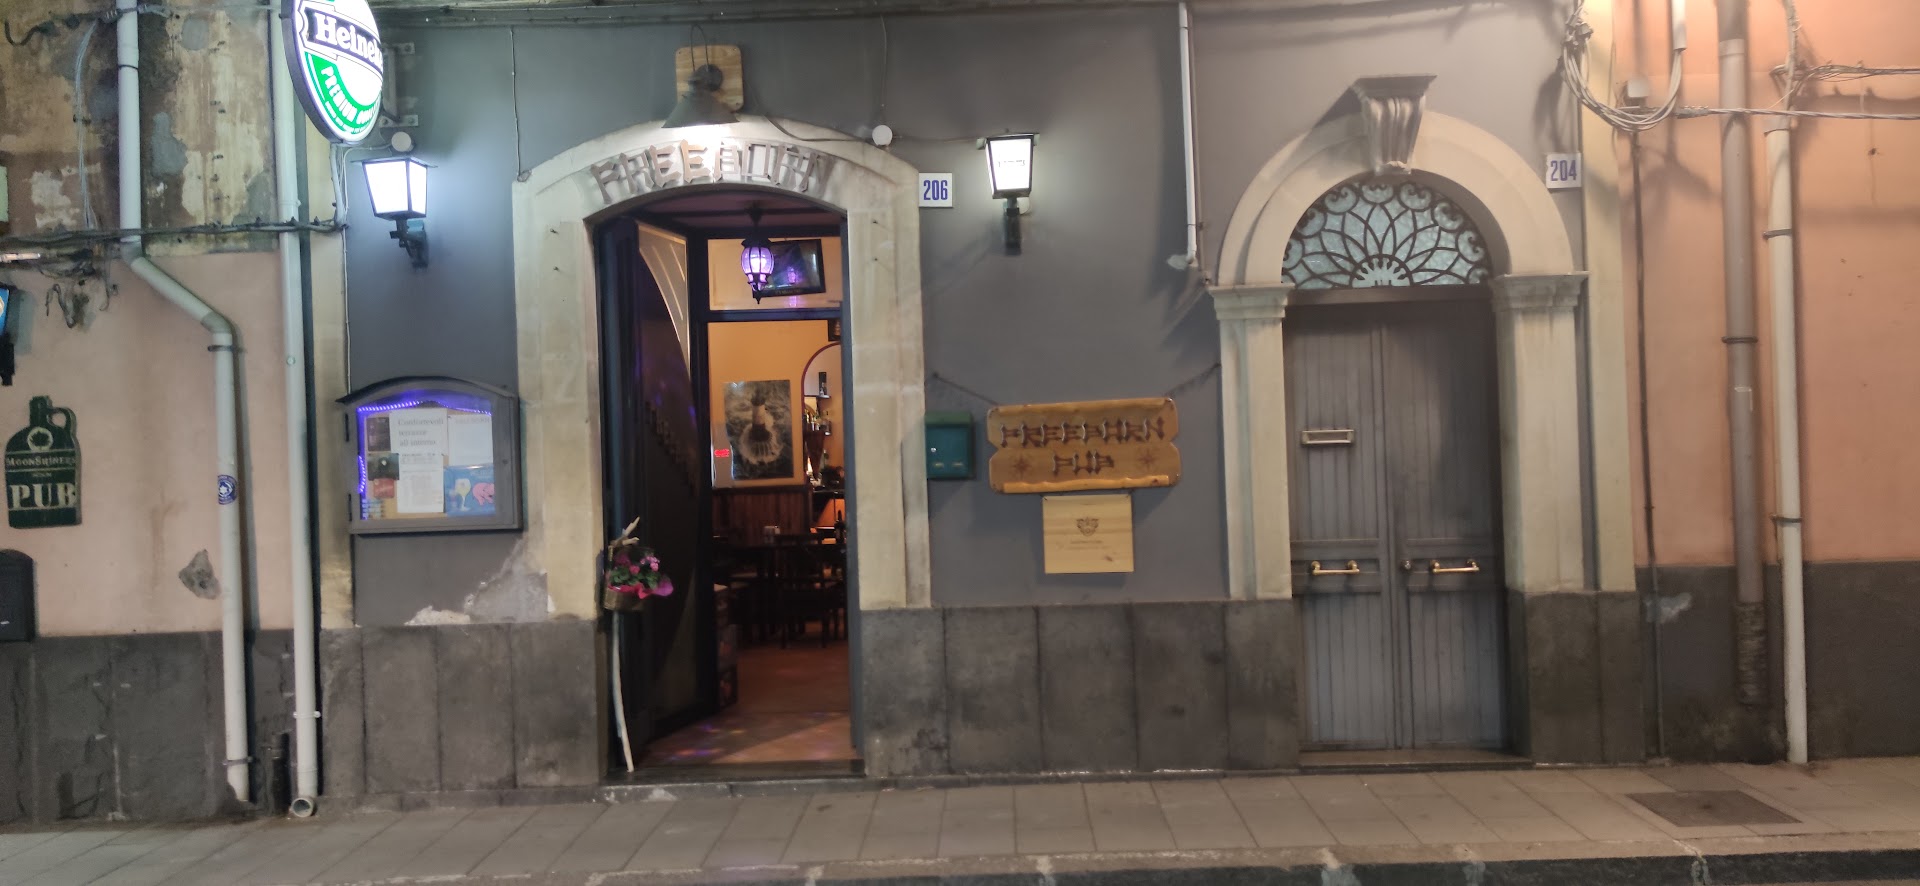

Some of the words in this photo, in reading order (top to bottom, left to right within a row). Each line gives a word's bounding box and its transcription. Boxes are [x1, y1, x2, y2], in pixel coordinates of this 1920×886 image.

[320, 65, 358, 123] PREMIUM
[591, 139, 838, 204] FREEBORN
[1550, 159, 1577, 182] 204
[923, 179, 948, 201] 206
[999, 415, 1165, 449] FREEBORN
[1052, 450, 1116, 478] PUB
[9, 482, 77, 511] PUB
